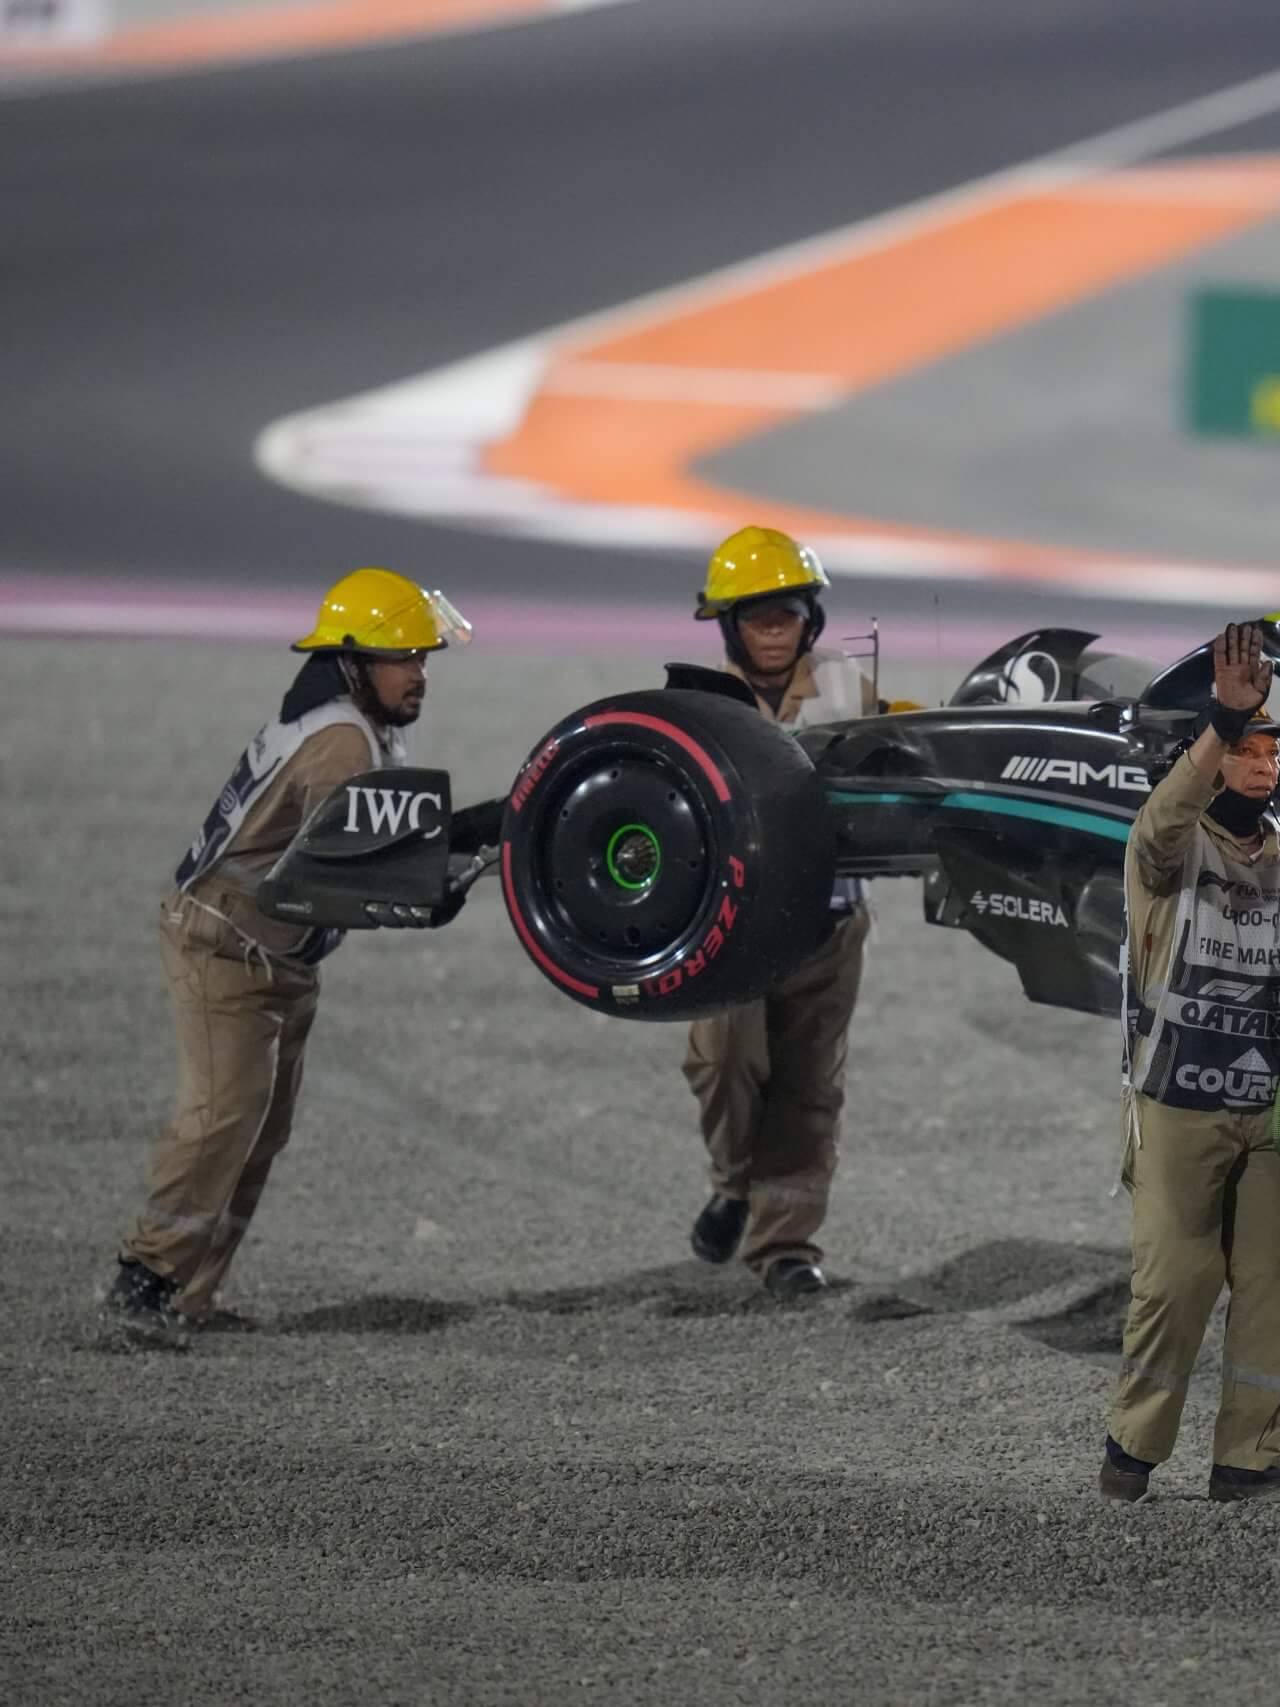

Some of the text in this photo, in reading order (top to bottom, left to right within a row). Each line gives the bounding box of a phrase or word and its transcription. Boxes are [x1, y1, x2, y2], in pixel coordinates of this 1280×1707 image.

[344, 786, 442, 839] IWC
[989, 893, 1069, 929] SOLERA
[1200, 937, 1235, 960] FIRE
